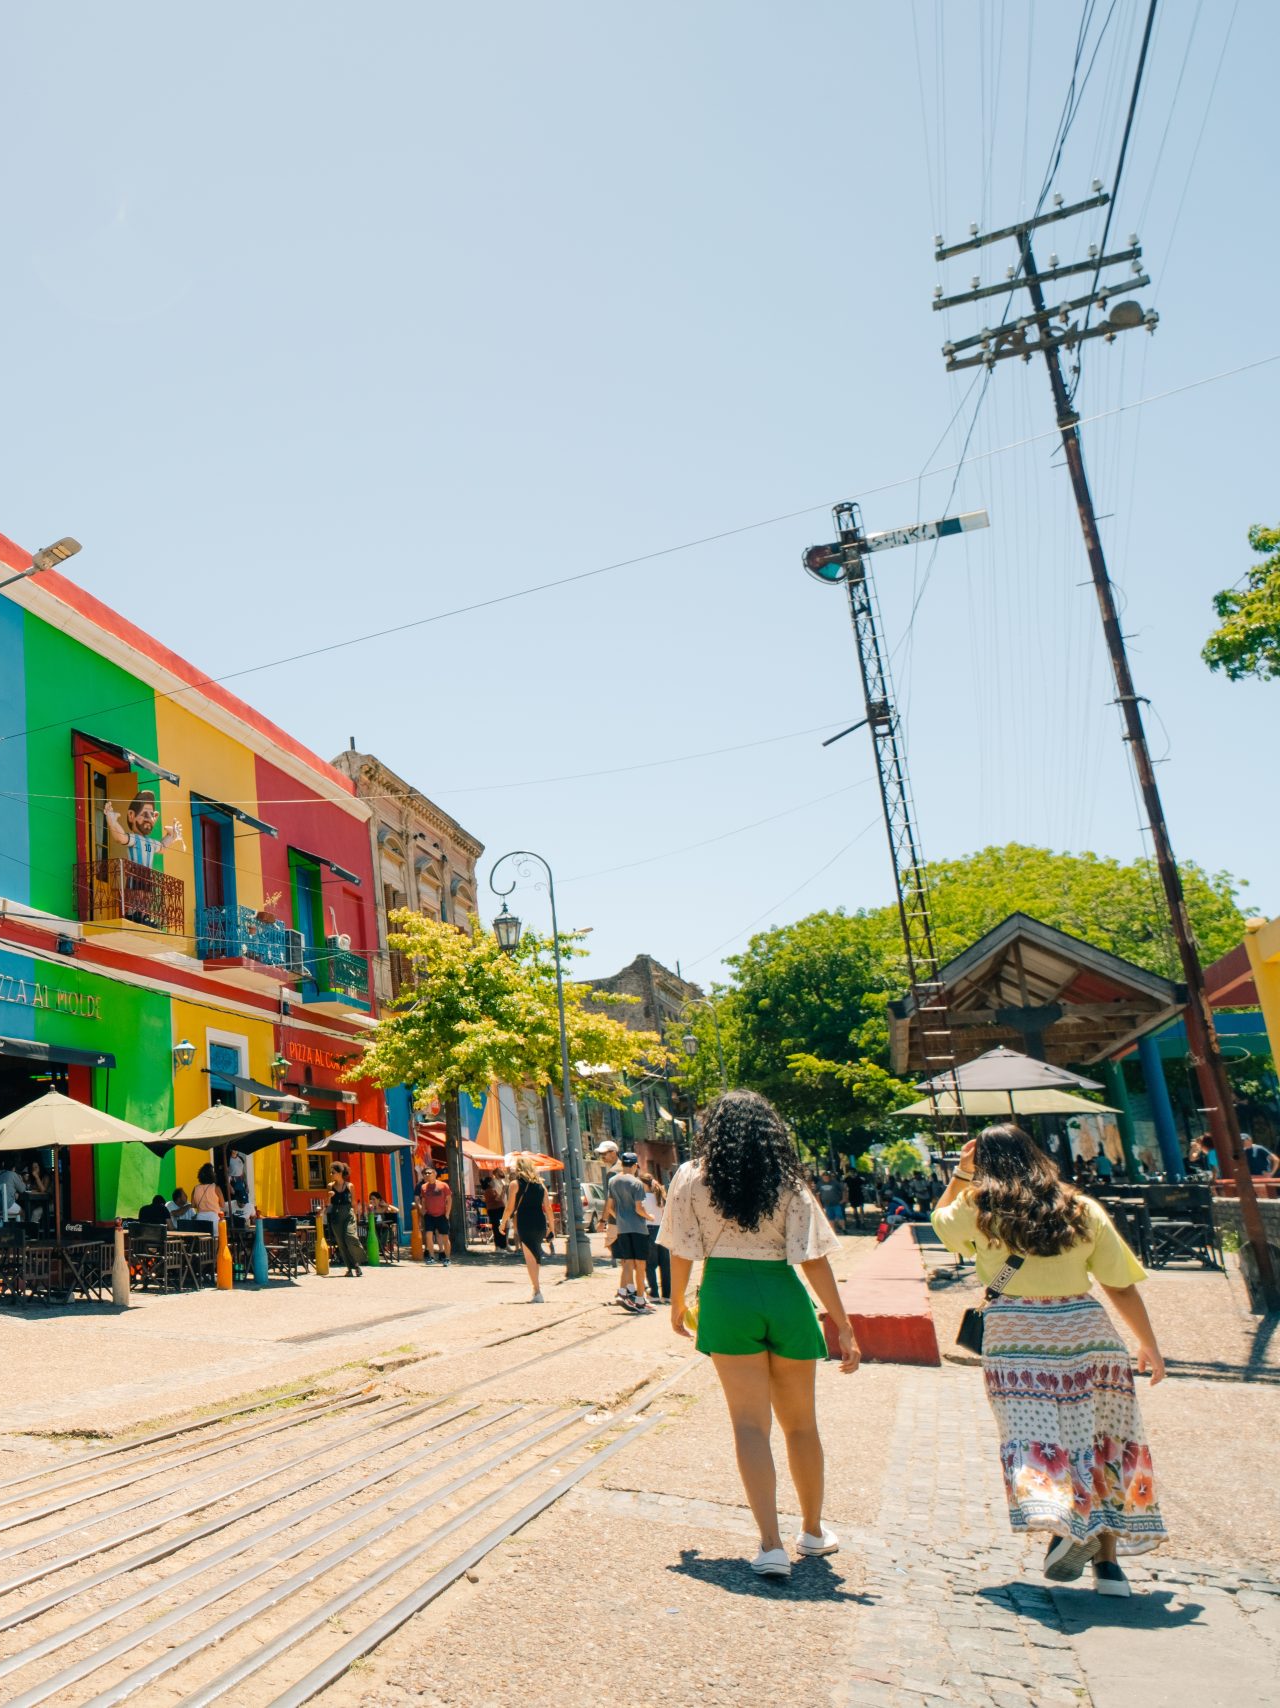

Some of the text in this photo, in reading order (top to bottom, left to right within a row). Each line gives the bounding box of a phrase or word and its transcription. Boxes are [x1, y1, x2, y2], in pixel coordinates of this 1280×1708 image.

[145, 844, 152, 853] 10
[57, 988, 102, 1020] MOLDE
[289, 1041, 313, 1064] PIZZA
[315, 1048, 325, 1067] AL
